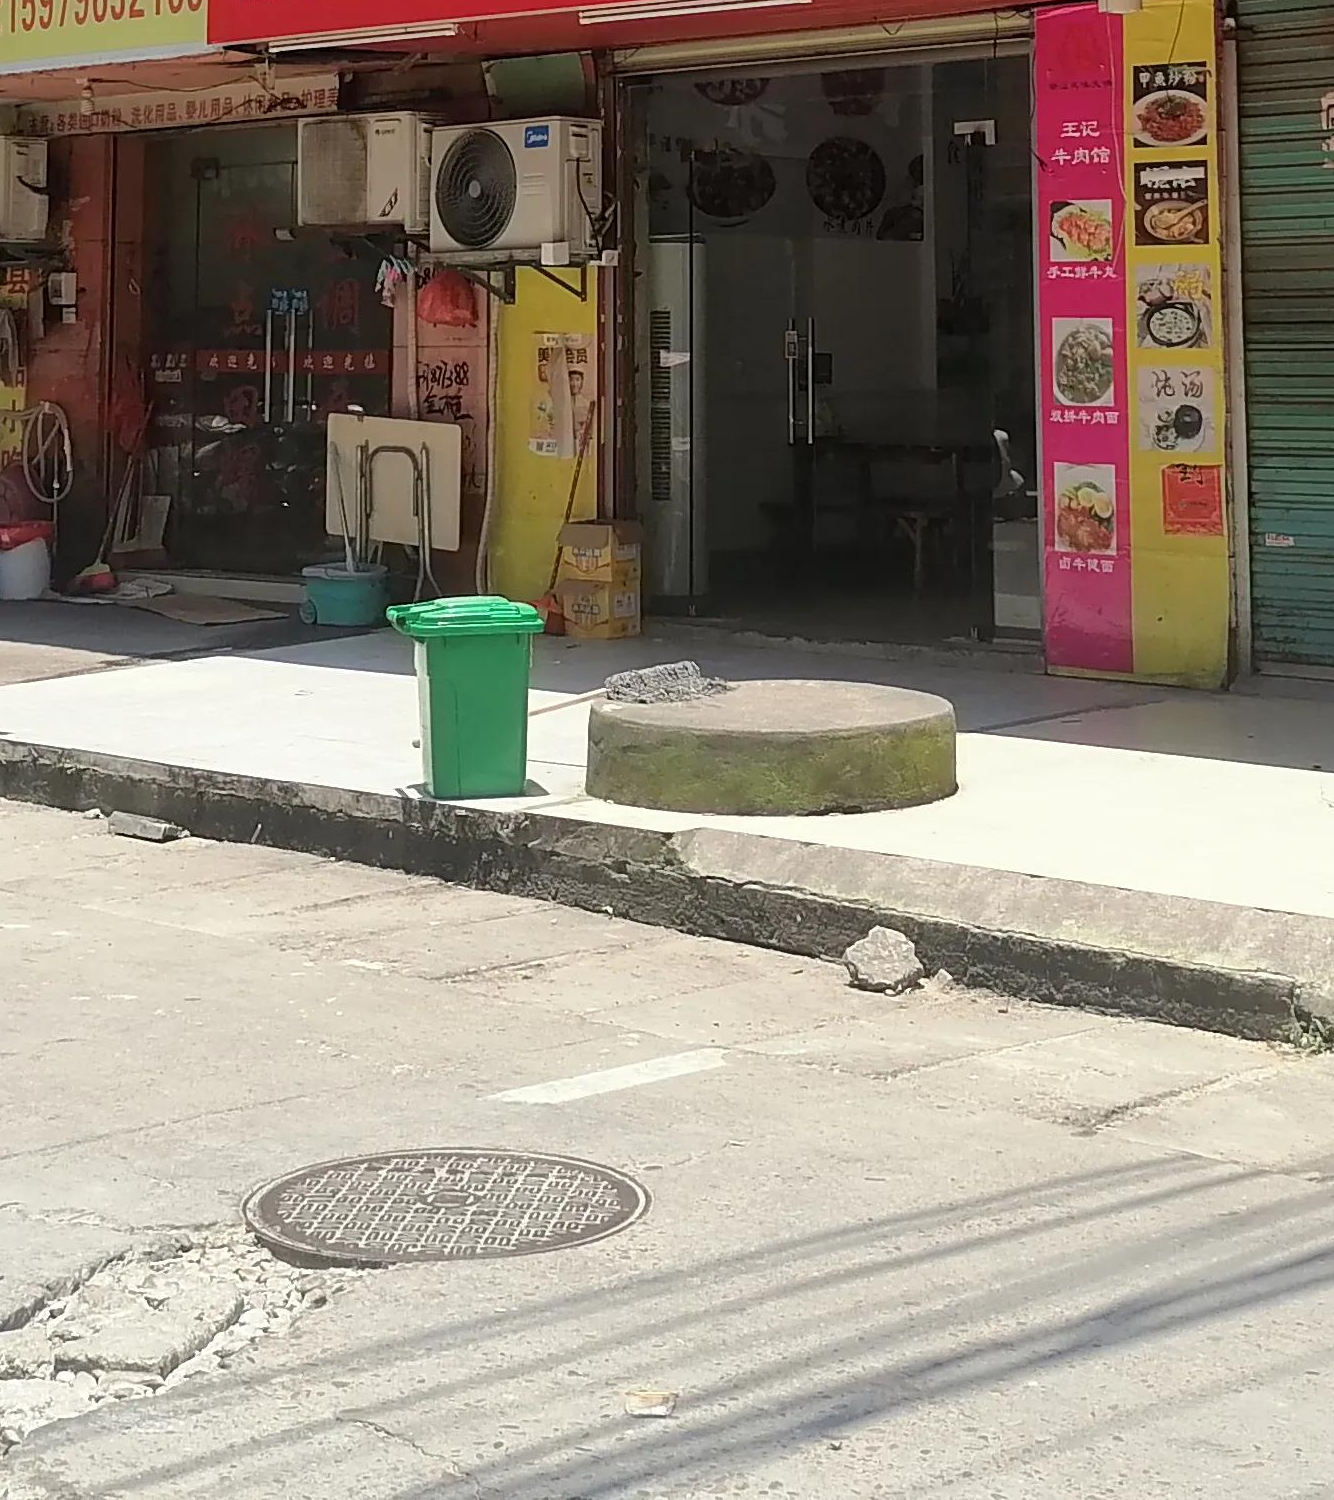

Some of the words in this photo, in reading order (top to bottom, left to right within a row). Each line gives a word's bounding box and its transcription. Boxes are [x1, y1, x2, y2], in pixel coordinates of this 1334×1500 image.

[1061, 121, 1100, 138] 王记
[1051, 149, 1110, 165] 牛肉馆
